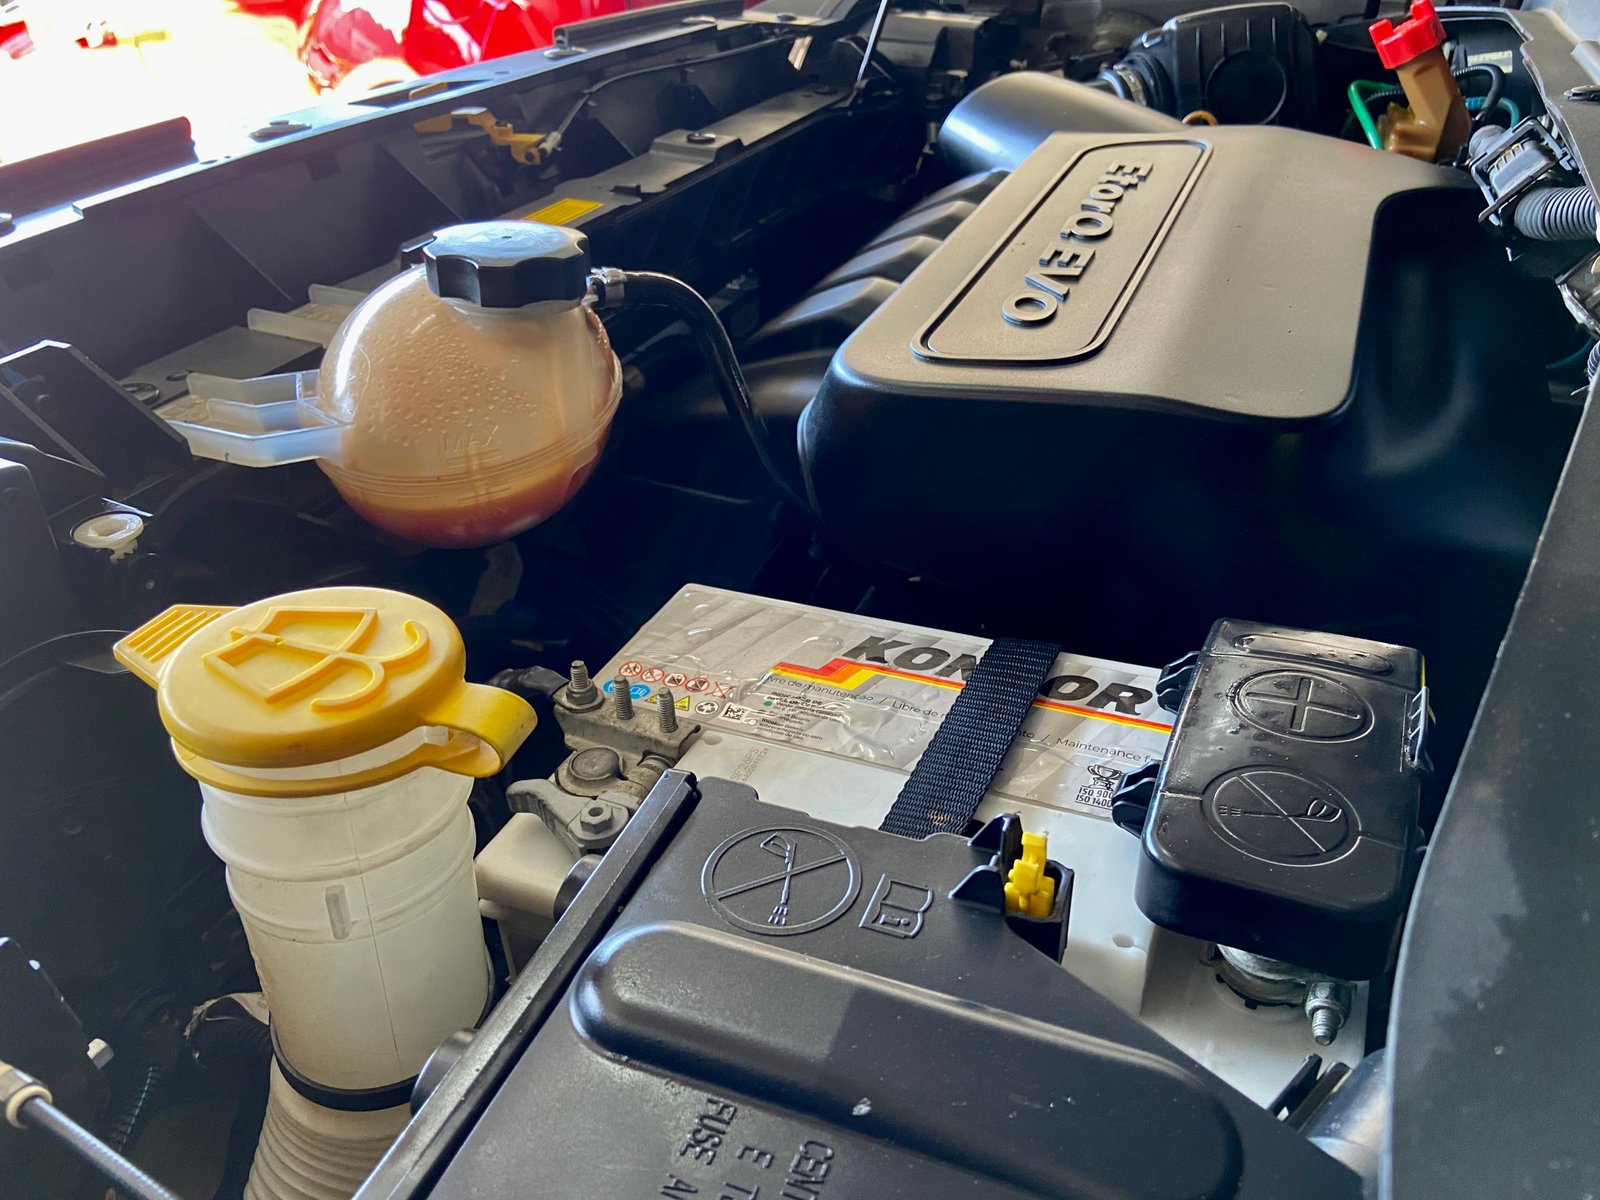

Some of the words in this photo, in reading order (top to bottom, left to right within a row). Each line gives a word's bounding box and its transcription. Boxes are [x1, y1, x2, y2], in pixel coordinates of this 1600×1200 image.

[1000, 242, 1096, 326] EVO
[841, 635, 1153, 716] KONOR
[787, 680, 802, 688] de
[804, 682, 874, 702] manutenção
[892, 701, 922, 713] Libre
[922, 708, 938, 718] de
[1055, 737, 1142, 761] Maintenance
[1075, 794, 1091, 803] ISO
[1078, 787, 1094, 796] ISO
[679, 1098, 738, 1166] FUSE
[736, 1145, 775, 1169] E
